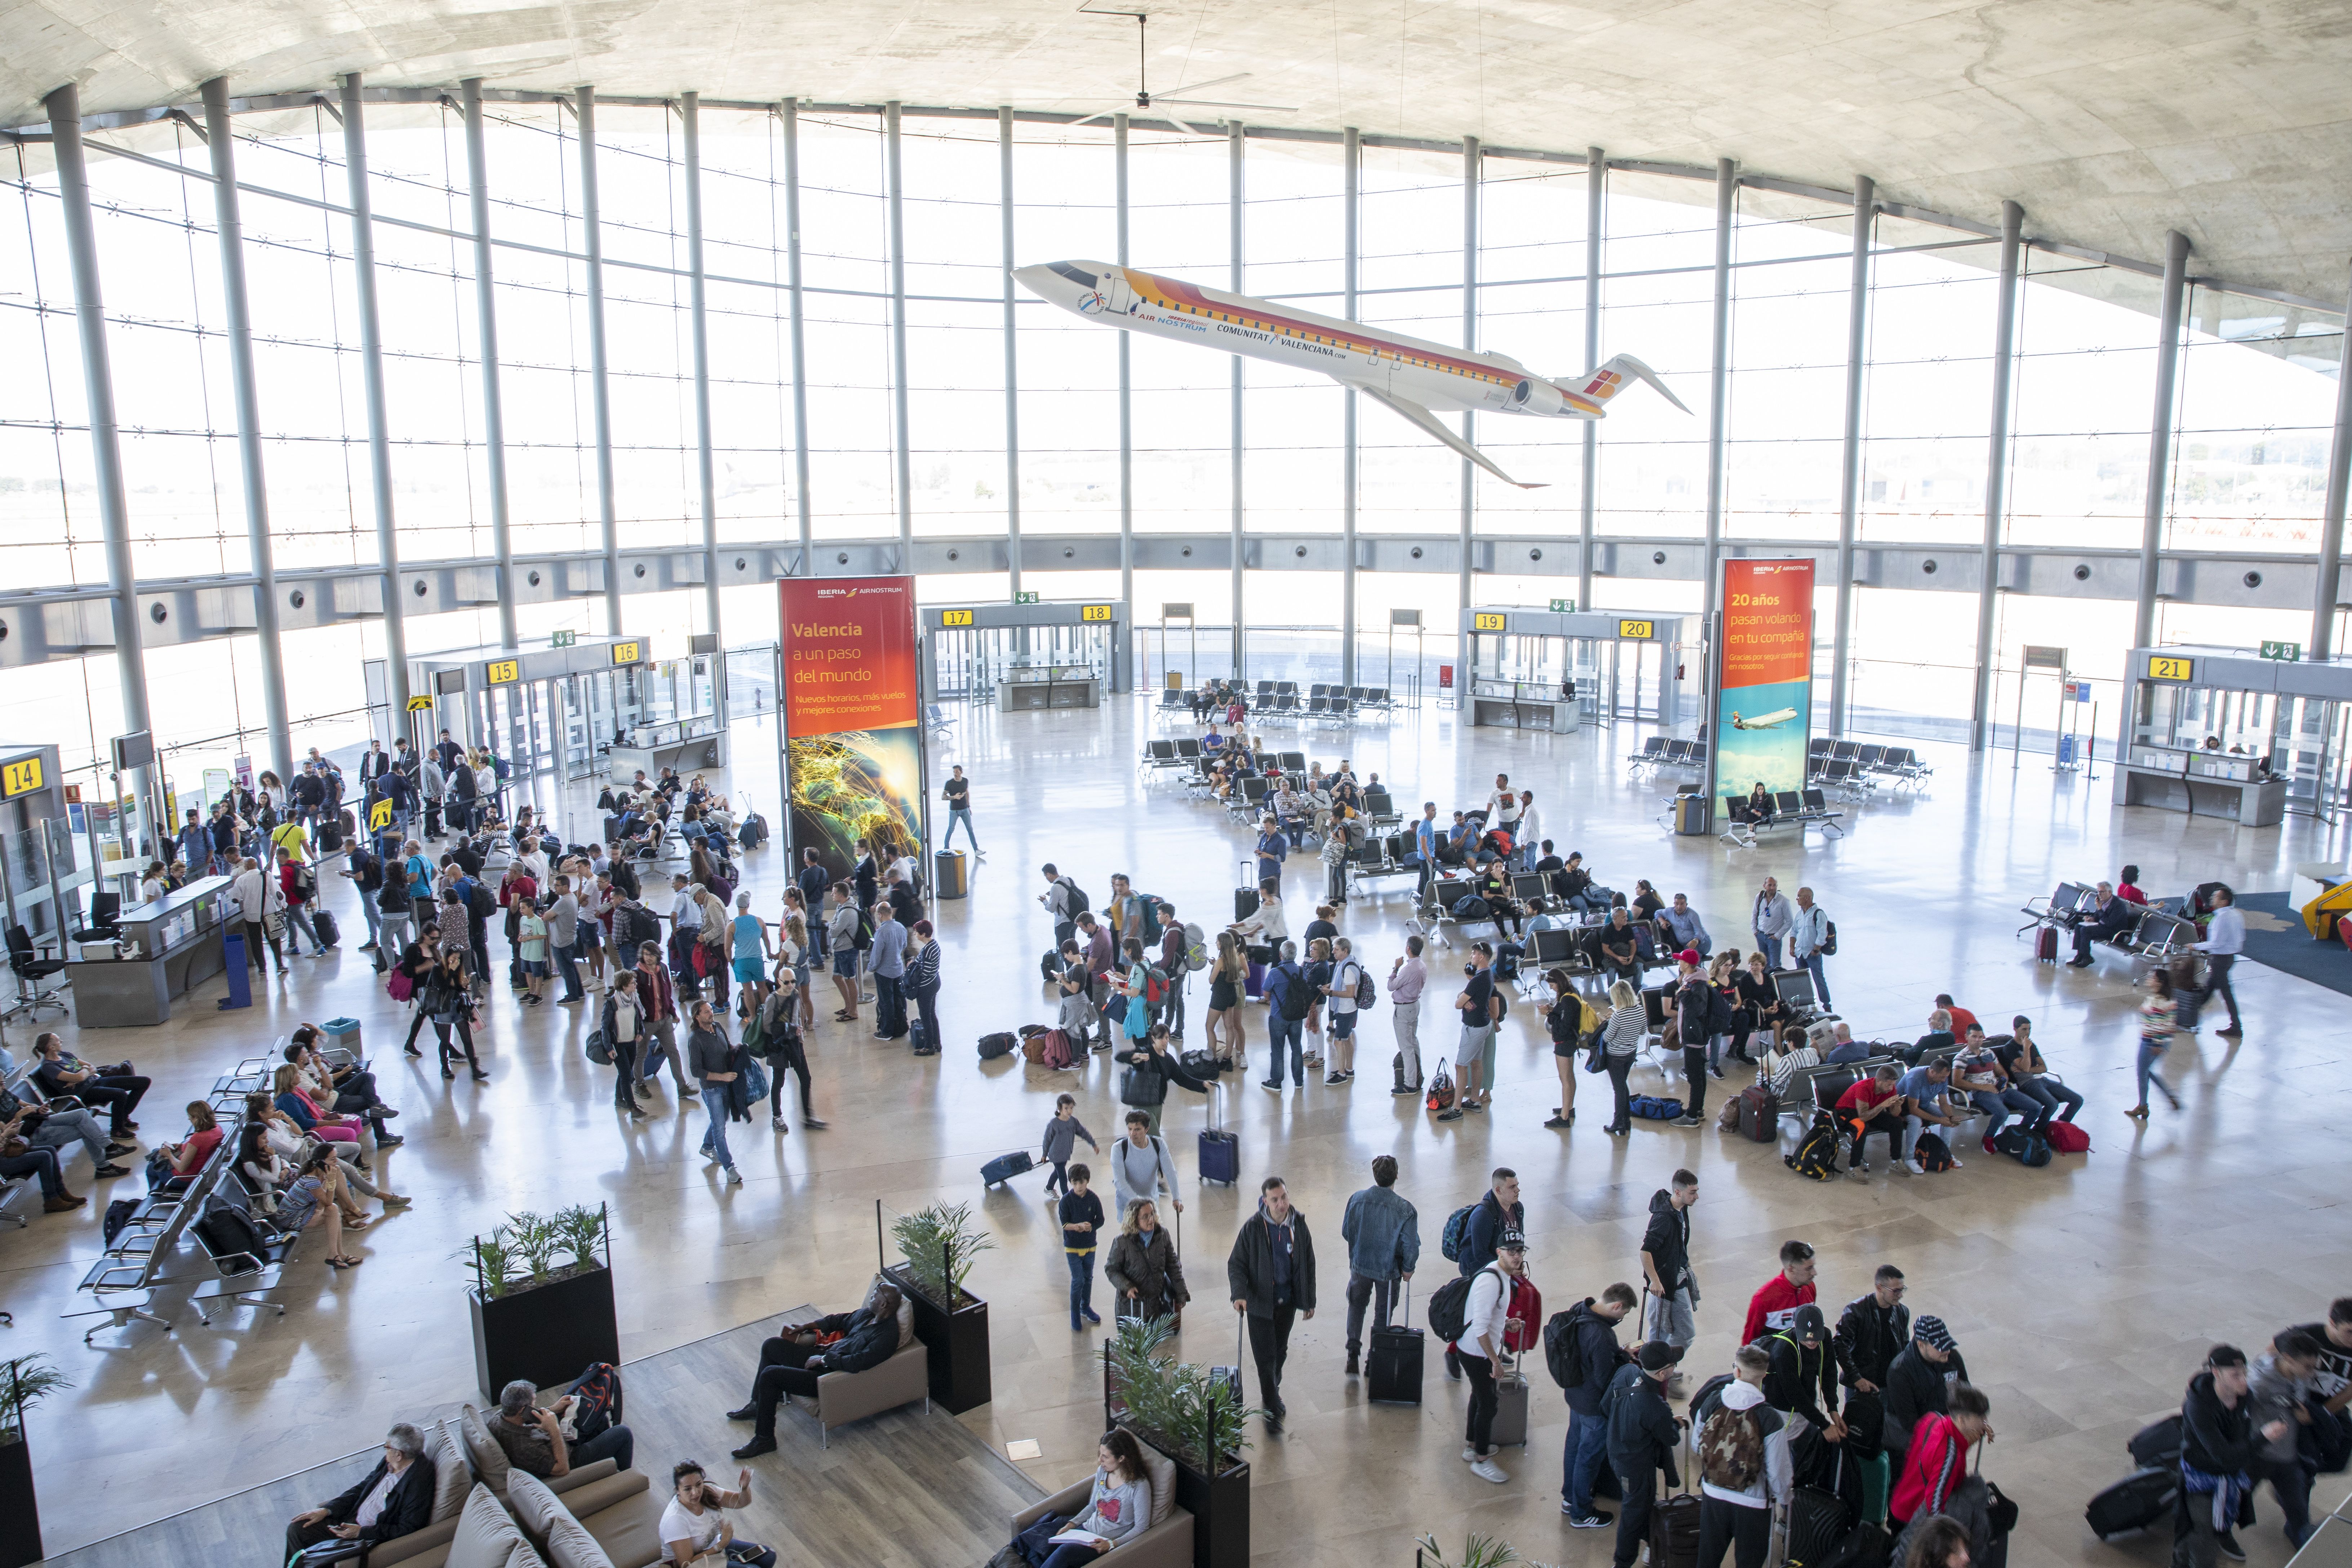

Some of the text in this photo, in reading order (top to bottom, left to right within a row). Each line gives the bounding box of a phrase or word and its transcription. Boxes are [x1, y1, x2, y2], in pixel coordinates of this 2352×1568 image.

[1138, 314, 1207, 333] AIR NOSTRUM
[1217, 324, 1270, 342] COMUNITAT
[1732, 594, 1780, 606] 20 años
[950, 612, 966, 624] 17
[1089, 607, 1105, 619] 18
[1730, 612, 1802, 627] pasan volando
[1481, 616, 1498, 628] 19
[1627, 623, 1645, 635] 20
[792, 622, 862, 637] Valencia
[1730, 630, 1804, 645] en tu compañía
[620, 645, 633, 661] 16
[793, 648, 861, 662] a un paso
[1763, 653, 1780, 661] seguir
[1781, 651, 1804, 659] confiando
[496, 663, 512, 680] 15
[1738, 662, 1764, 670] nosotros
[2158, 660, 2180, 678] 21
[794, 668, 871, 683] del mundo
[795, 691, 906, 703] Nuevos horarios, más vuelos
[796, 703, 882, 716] y mejores conexiones
[13, 763, 34, 791] 14
